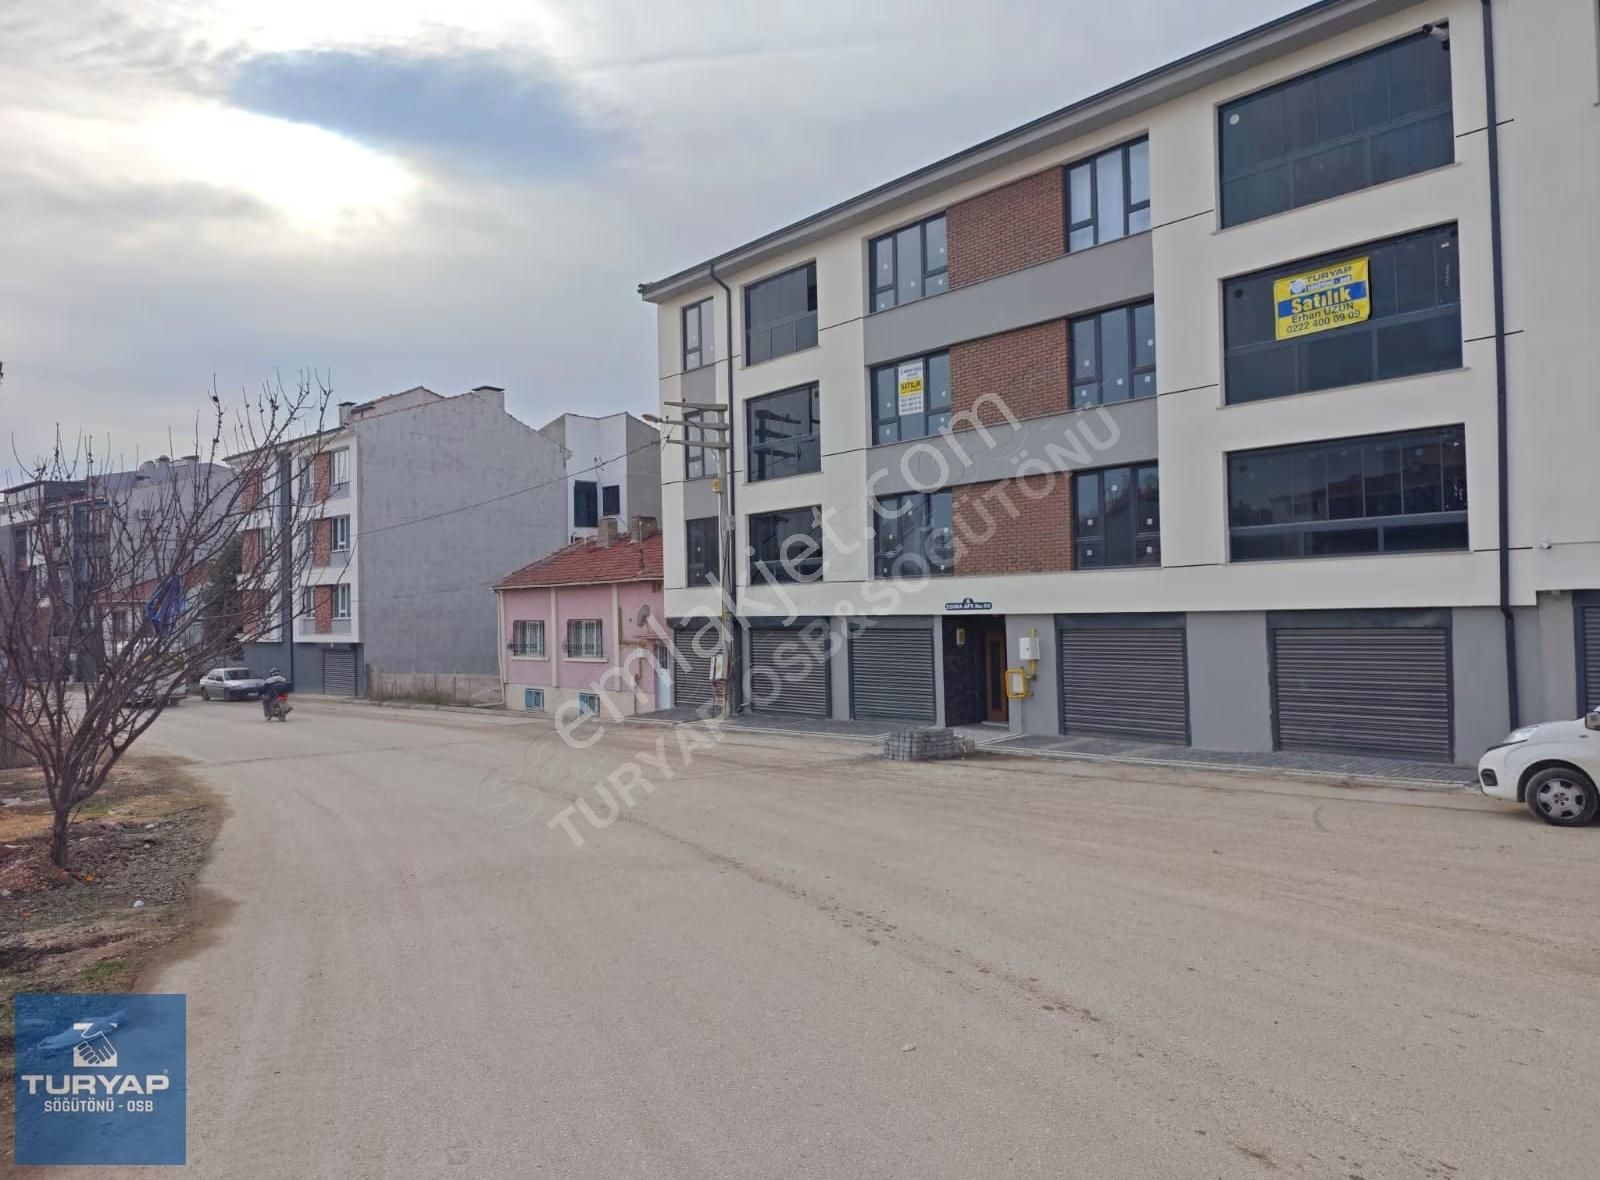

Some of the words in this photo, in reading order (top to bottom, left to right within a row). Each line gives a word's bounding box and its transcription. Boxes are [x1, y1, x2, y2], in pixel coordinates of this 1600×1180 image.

[1307, 266, 1352, 283] TURYAP
[1291, 287, 1352, 314] Satılık
[1286, 321, 1311, 334] 0222
[1312, 317, 1330, 328] 400
[1333, 313, 1345, 323] 09
[1291, 310, 1321, 324] Erhan
[1324, 302, 1354, 316] UZUN
